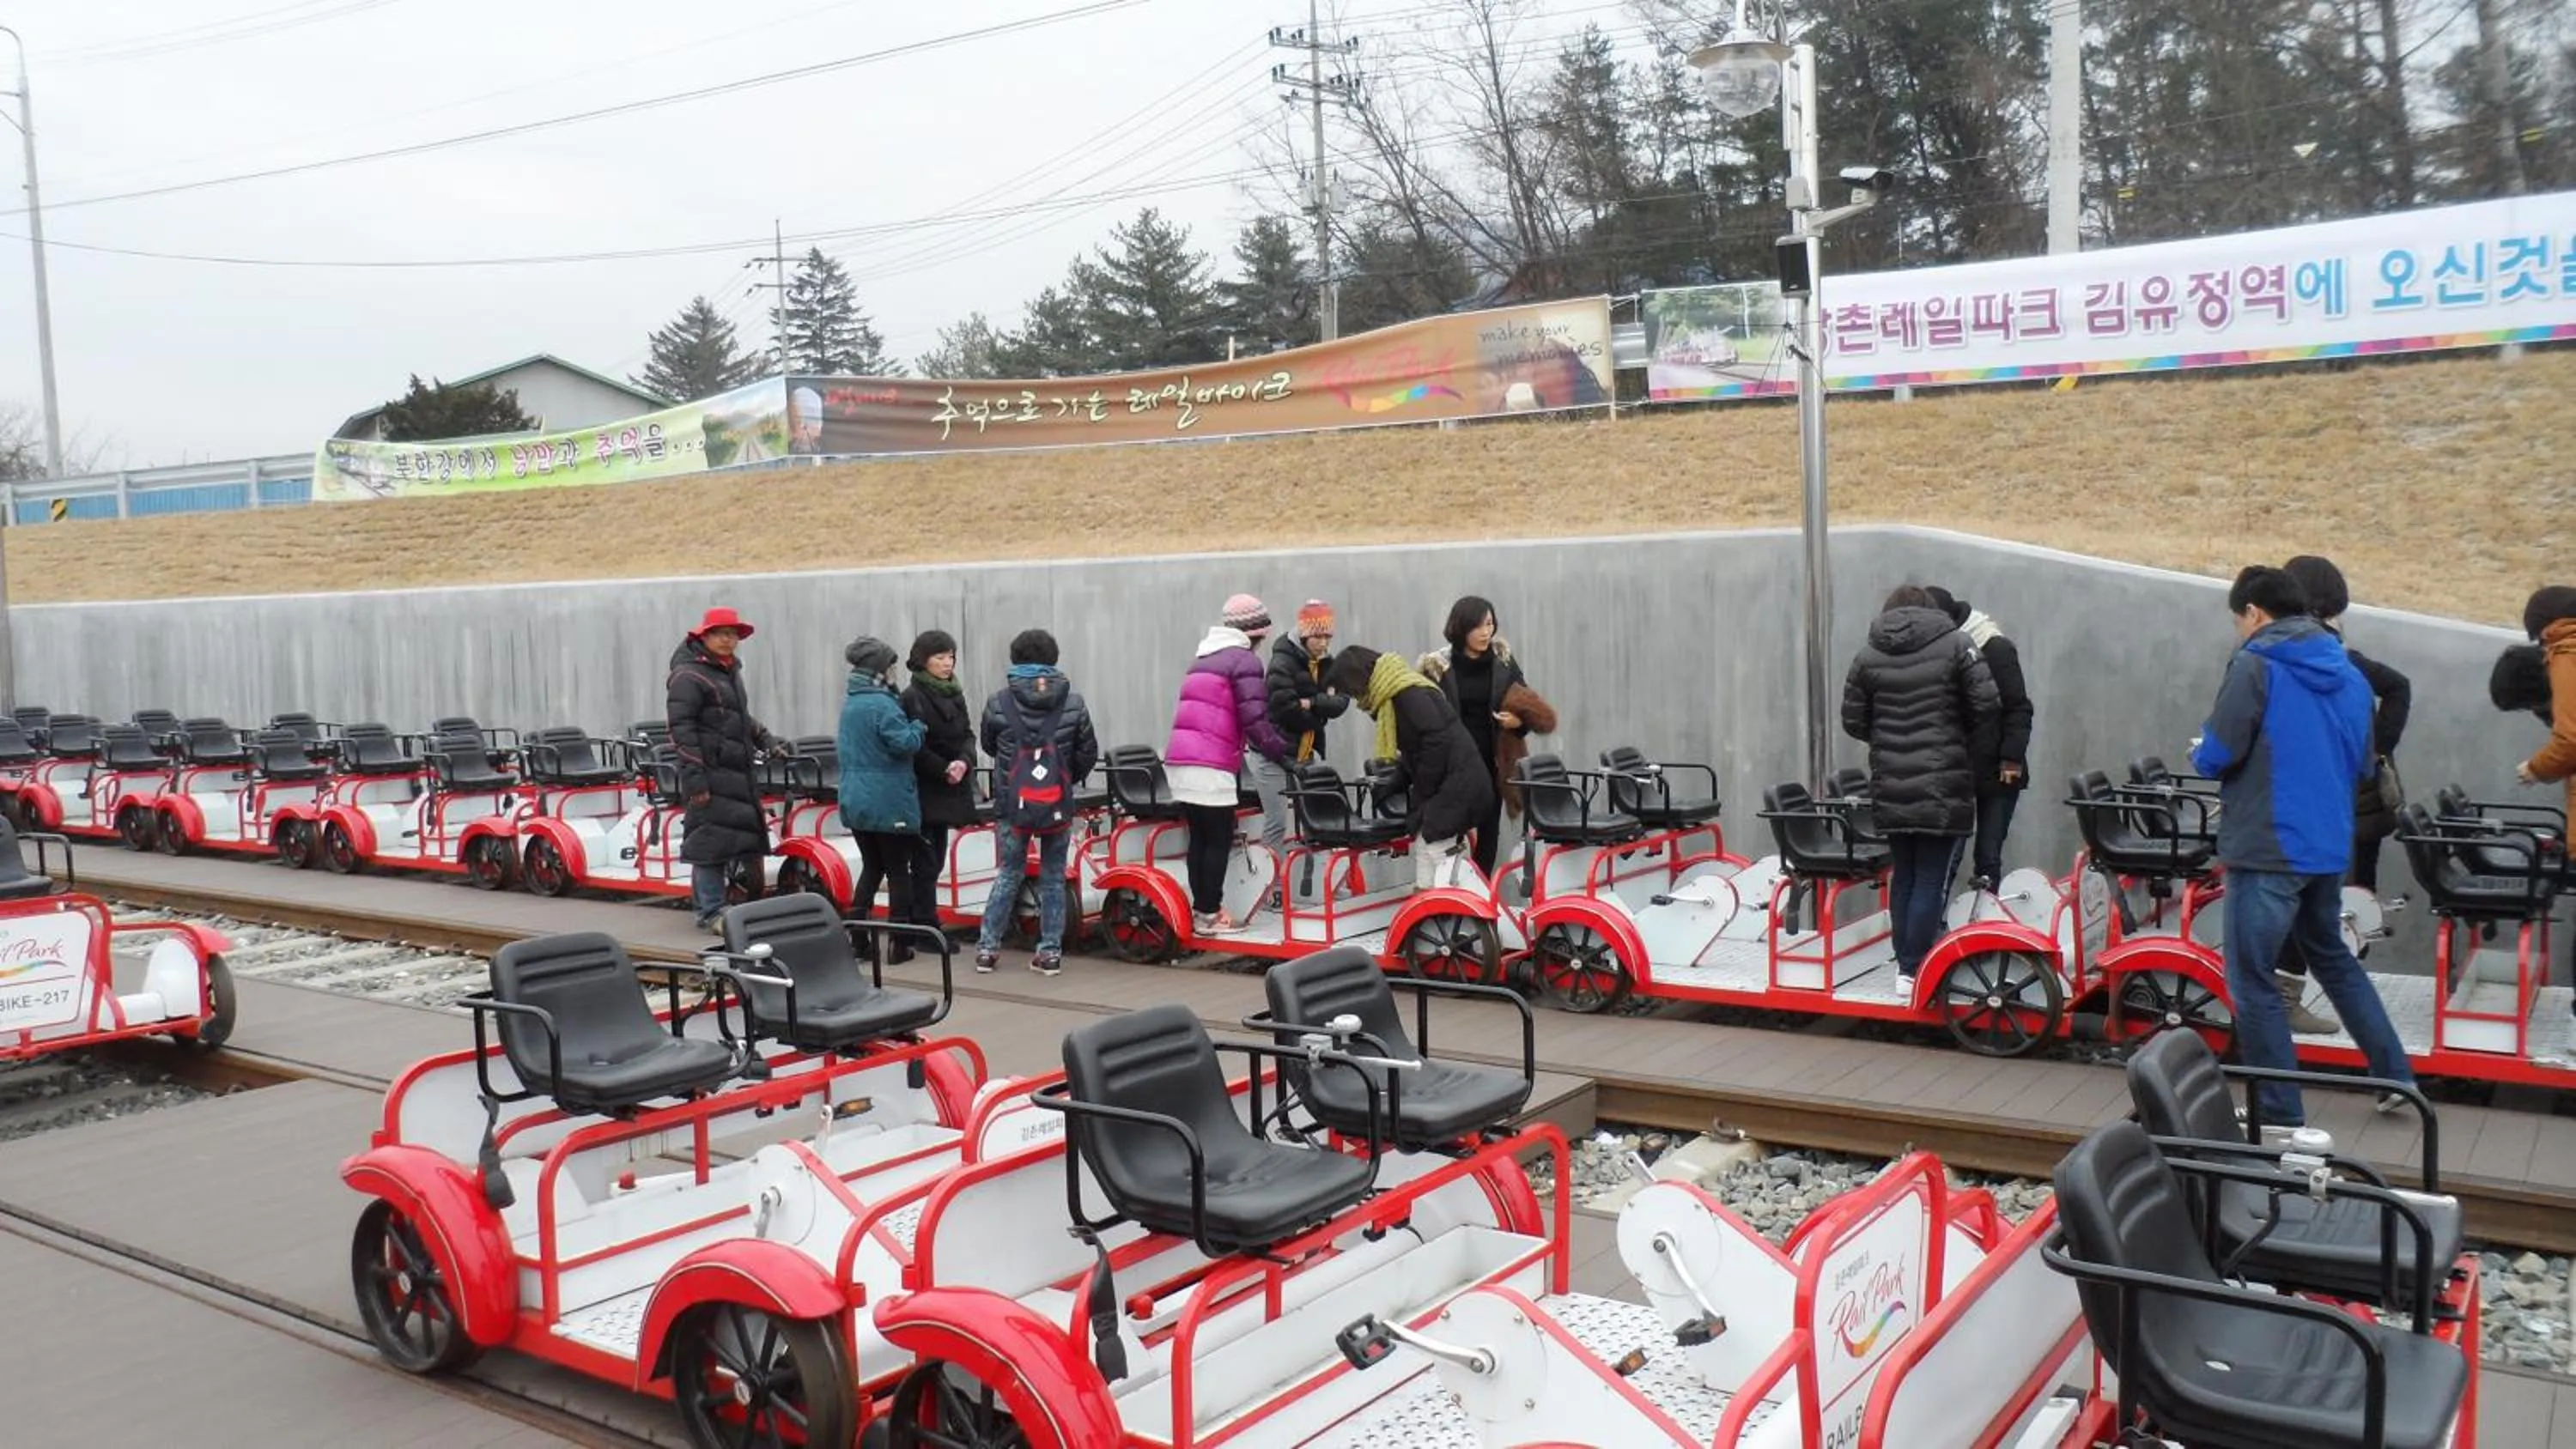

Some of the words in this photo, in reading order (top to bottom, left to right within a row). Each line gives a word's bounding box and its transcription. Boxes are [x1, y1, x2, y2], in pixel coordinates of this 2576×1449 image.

[2084, 258, 2343, 334] 김유정역에
[1480, 320, 1530, 342] make
[1535, 323, 1570, 345] your
[931, 386, 1043, 440] 추억으로
[1125, 372, 1291, 429] 레일바이크
[394, 446, 497, 484] 북한강에서
[510, 438, 578, 478] 낭만과
